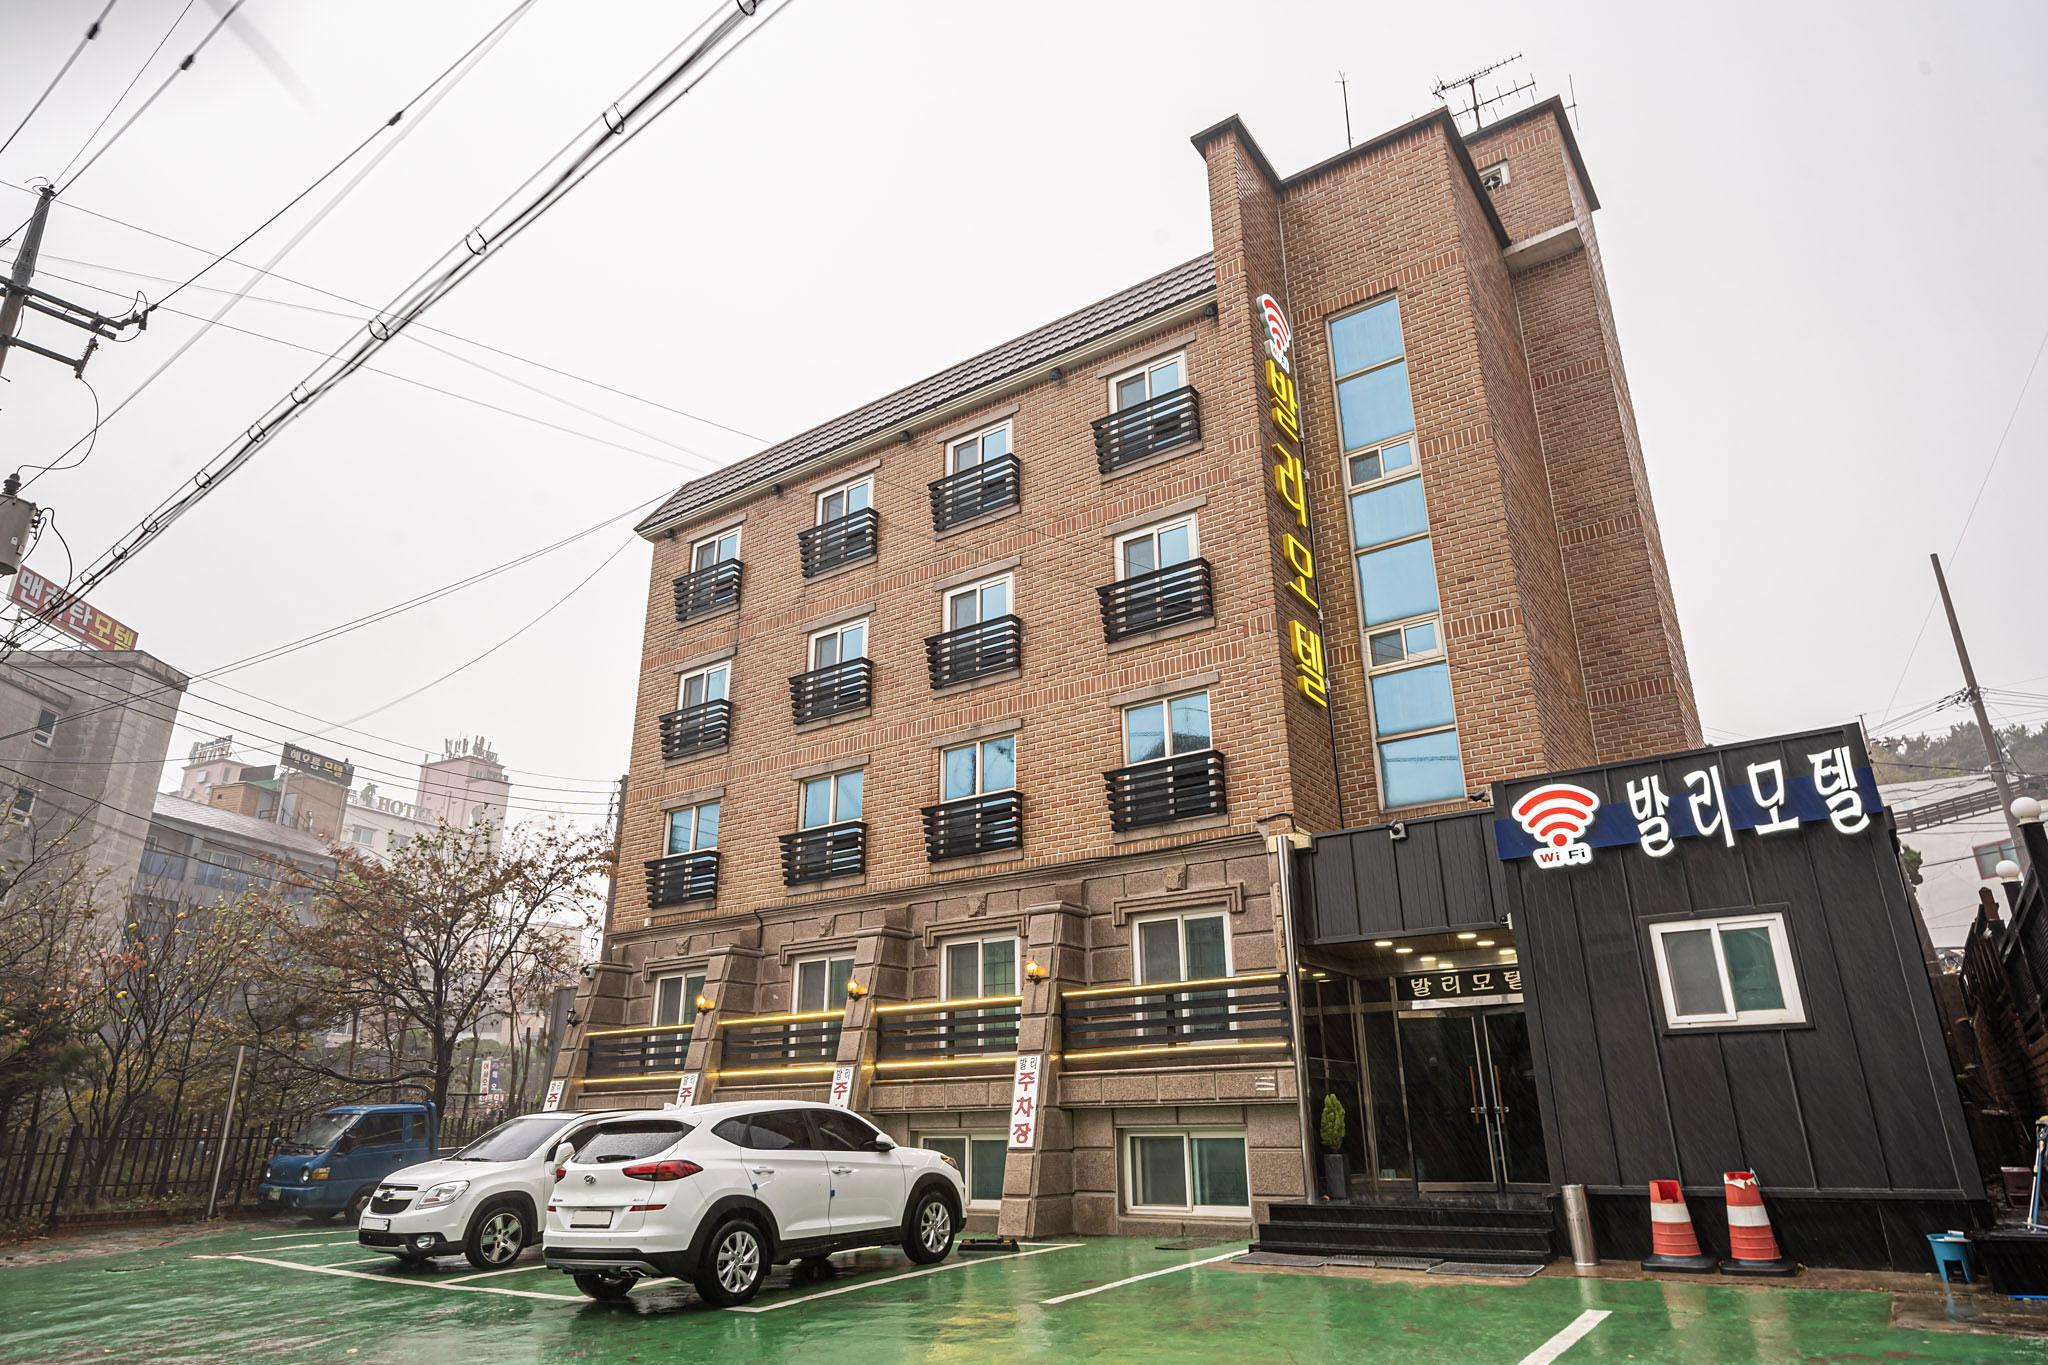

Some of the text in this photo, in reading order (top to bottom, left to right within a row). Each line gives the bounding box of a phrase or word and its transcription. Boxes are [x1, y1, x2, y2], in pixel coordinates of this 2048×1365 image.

[1265, 359, 1328, 708] 발리모텔
[1626, 746, 1871, 857] 발리모텔
[1013, 1071, 1035, 1144] 주차장
